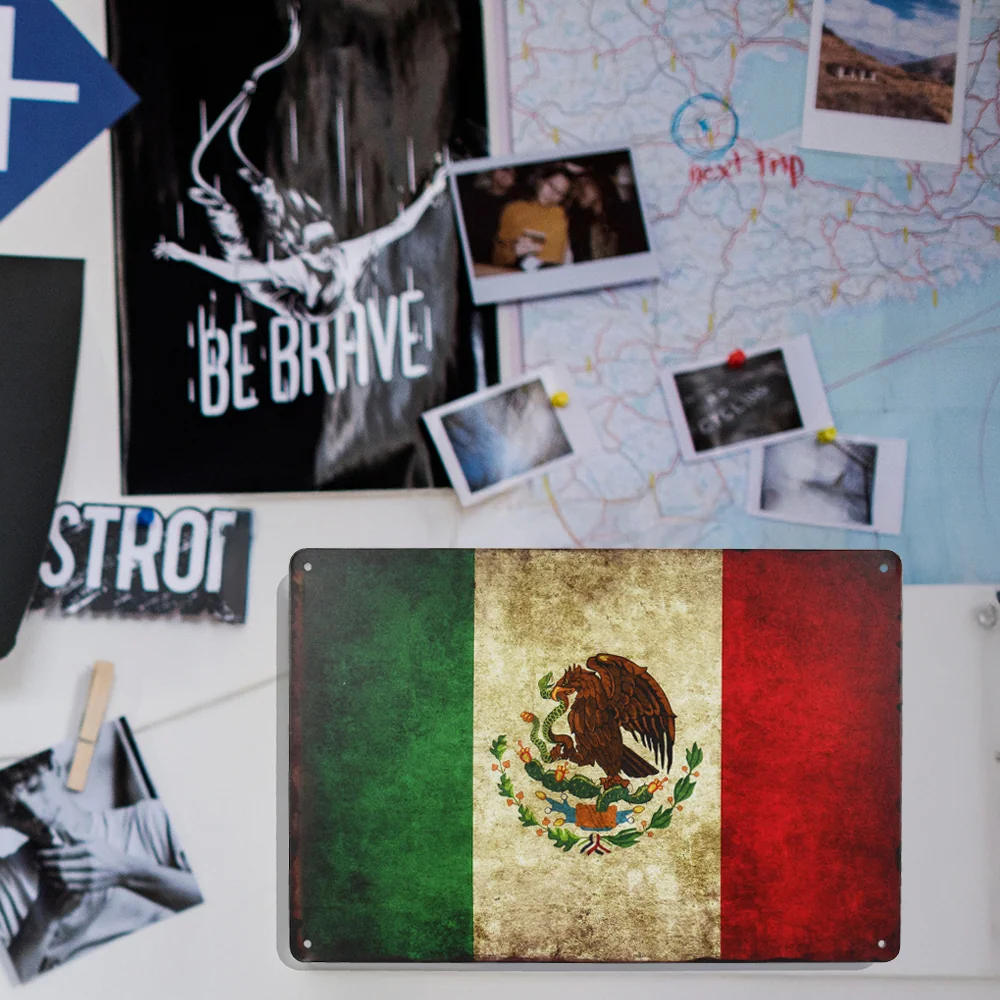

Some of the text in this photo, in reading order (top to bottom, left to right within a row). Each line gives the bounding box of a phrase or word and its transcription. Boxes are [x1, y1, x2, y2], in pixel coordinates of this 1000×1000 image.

[689, 148, 805, 189] next trip
[199, 288, 429, 417] BE BRAVE
